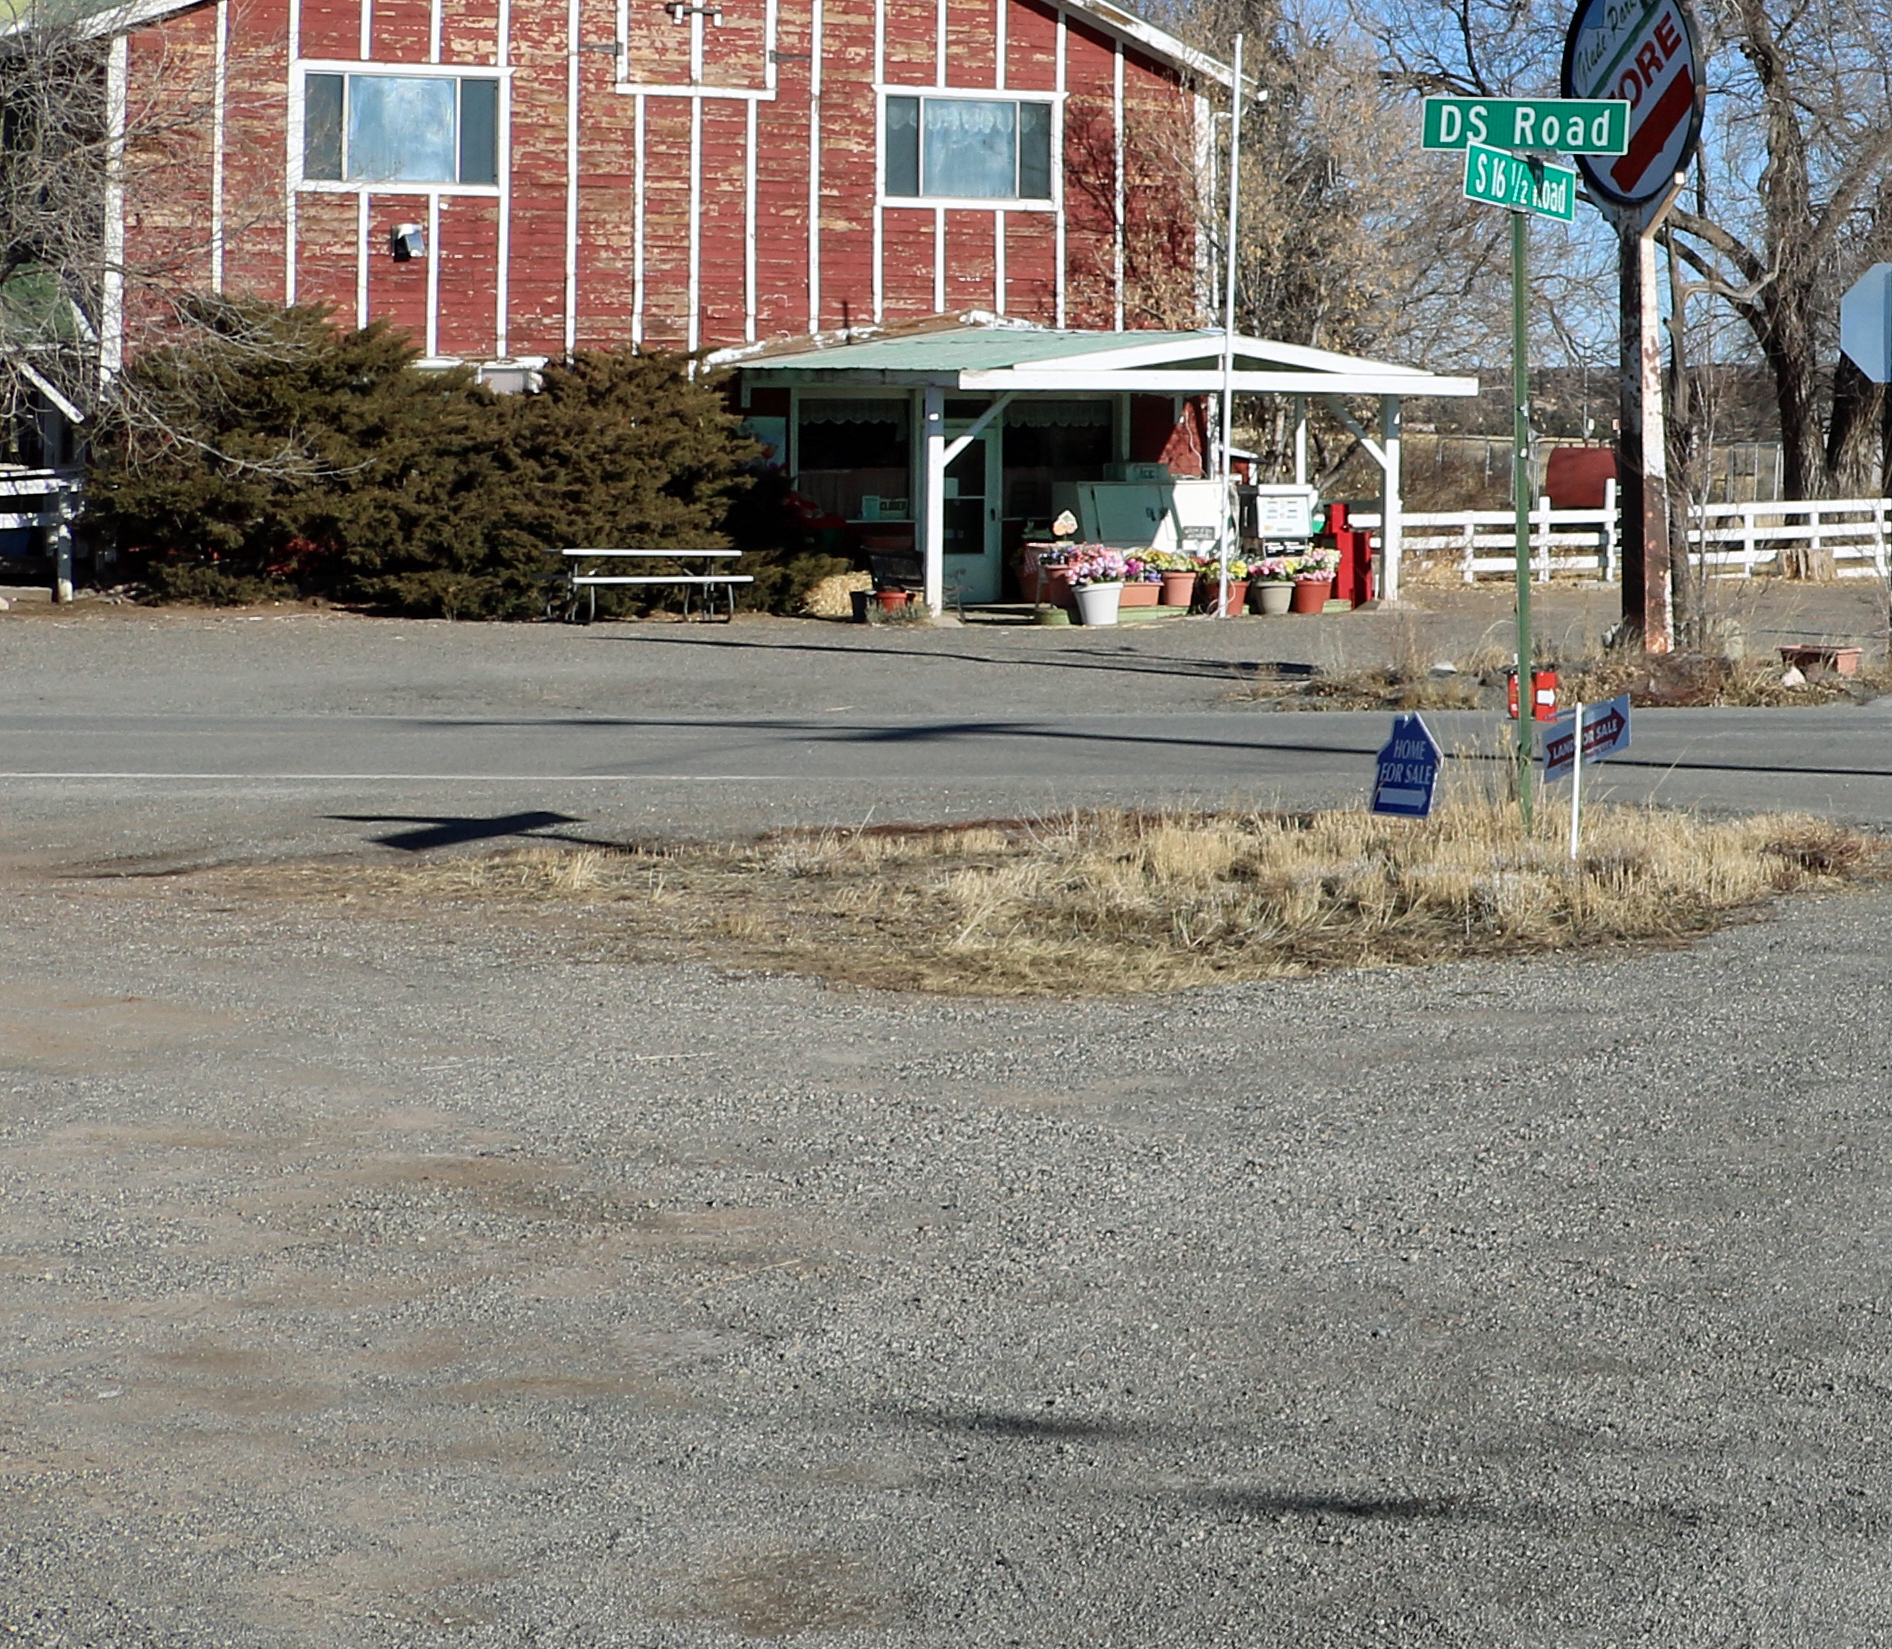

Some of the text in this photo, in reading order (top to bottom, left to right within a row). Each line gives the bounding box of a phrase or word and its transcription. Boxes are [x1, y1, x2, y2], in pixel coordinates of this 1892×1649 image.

[1576, 30, 1607, 93] Glade
[1606, 10, 1682, 111] ORE
[1439, 104, 1611, 147] DS Road
[1475, 152, 1488, 193] S
[1491, 157, 1506, 199] 16
[1393, 739, 1427, 760] HOME
[1596, 718, 1618, 740] SALE
[1380, 762, 1434, 785] FOR SALE
